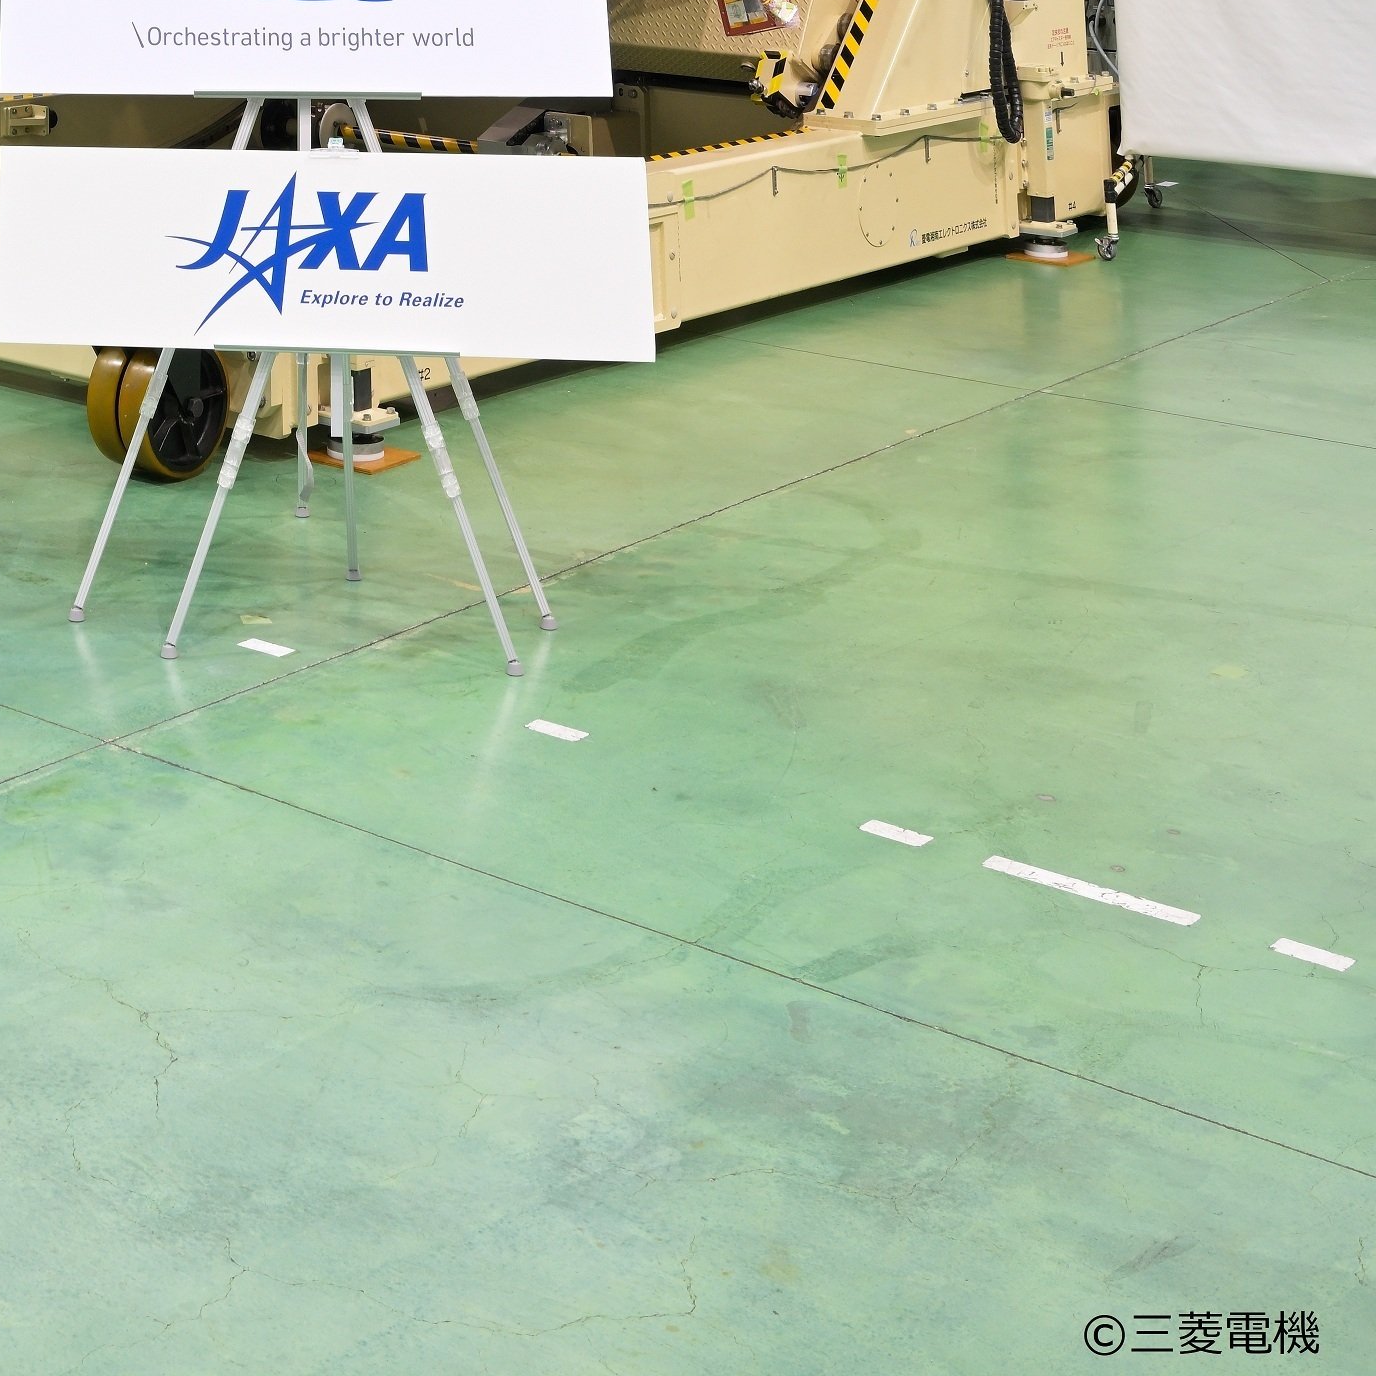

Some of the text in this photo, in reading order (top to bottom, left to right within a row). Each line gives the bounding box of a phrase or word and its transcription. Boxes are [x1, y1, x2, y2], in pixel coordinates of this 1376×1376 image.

[300, 31, 311, 47] a
[318, 27, 405, 51] brighter
[412, 28, 475, 47] world
[164, 170, 429, 336] JAXA
[300, 289, 465, 309] Explore to Realize
